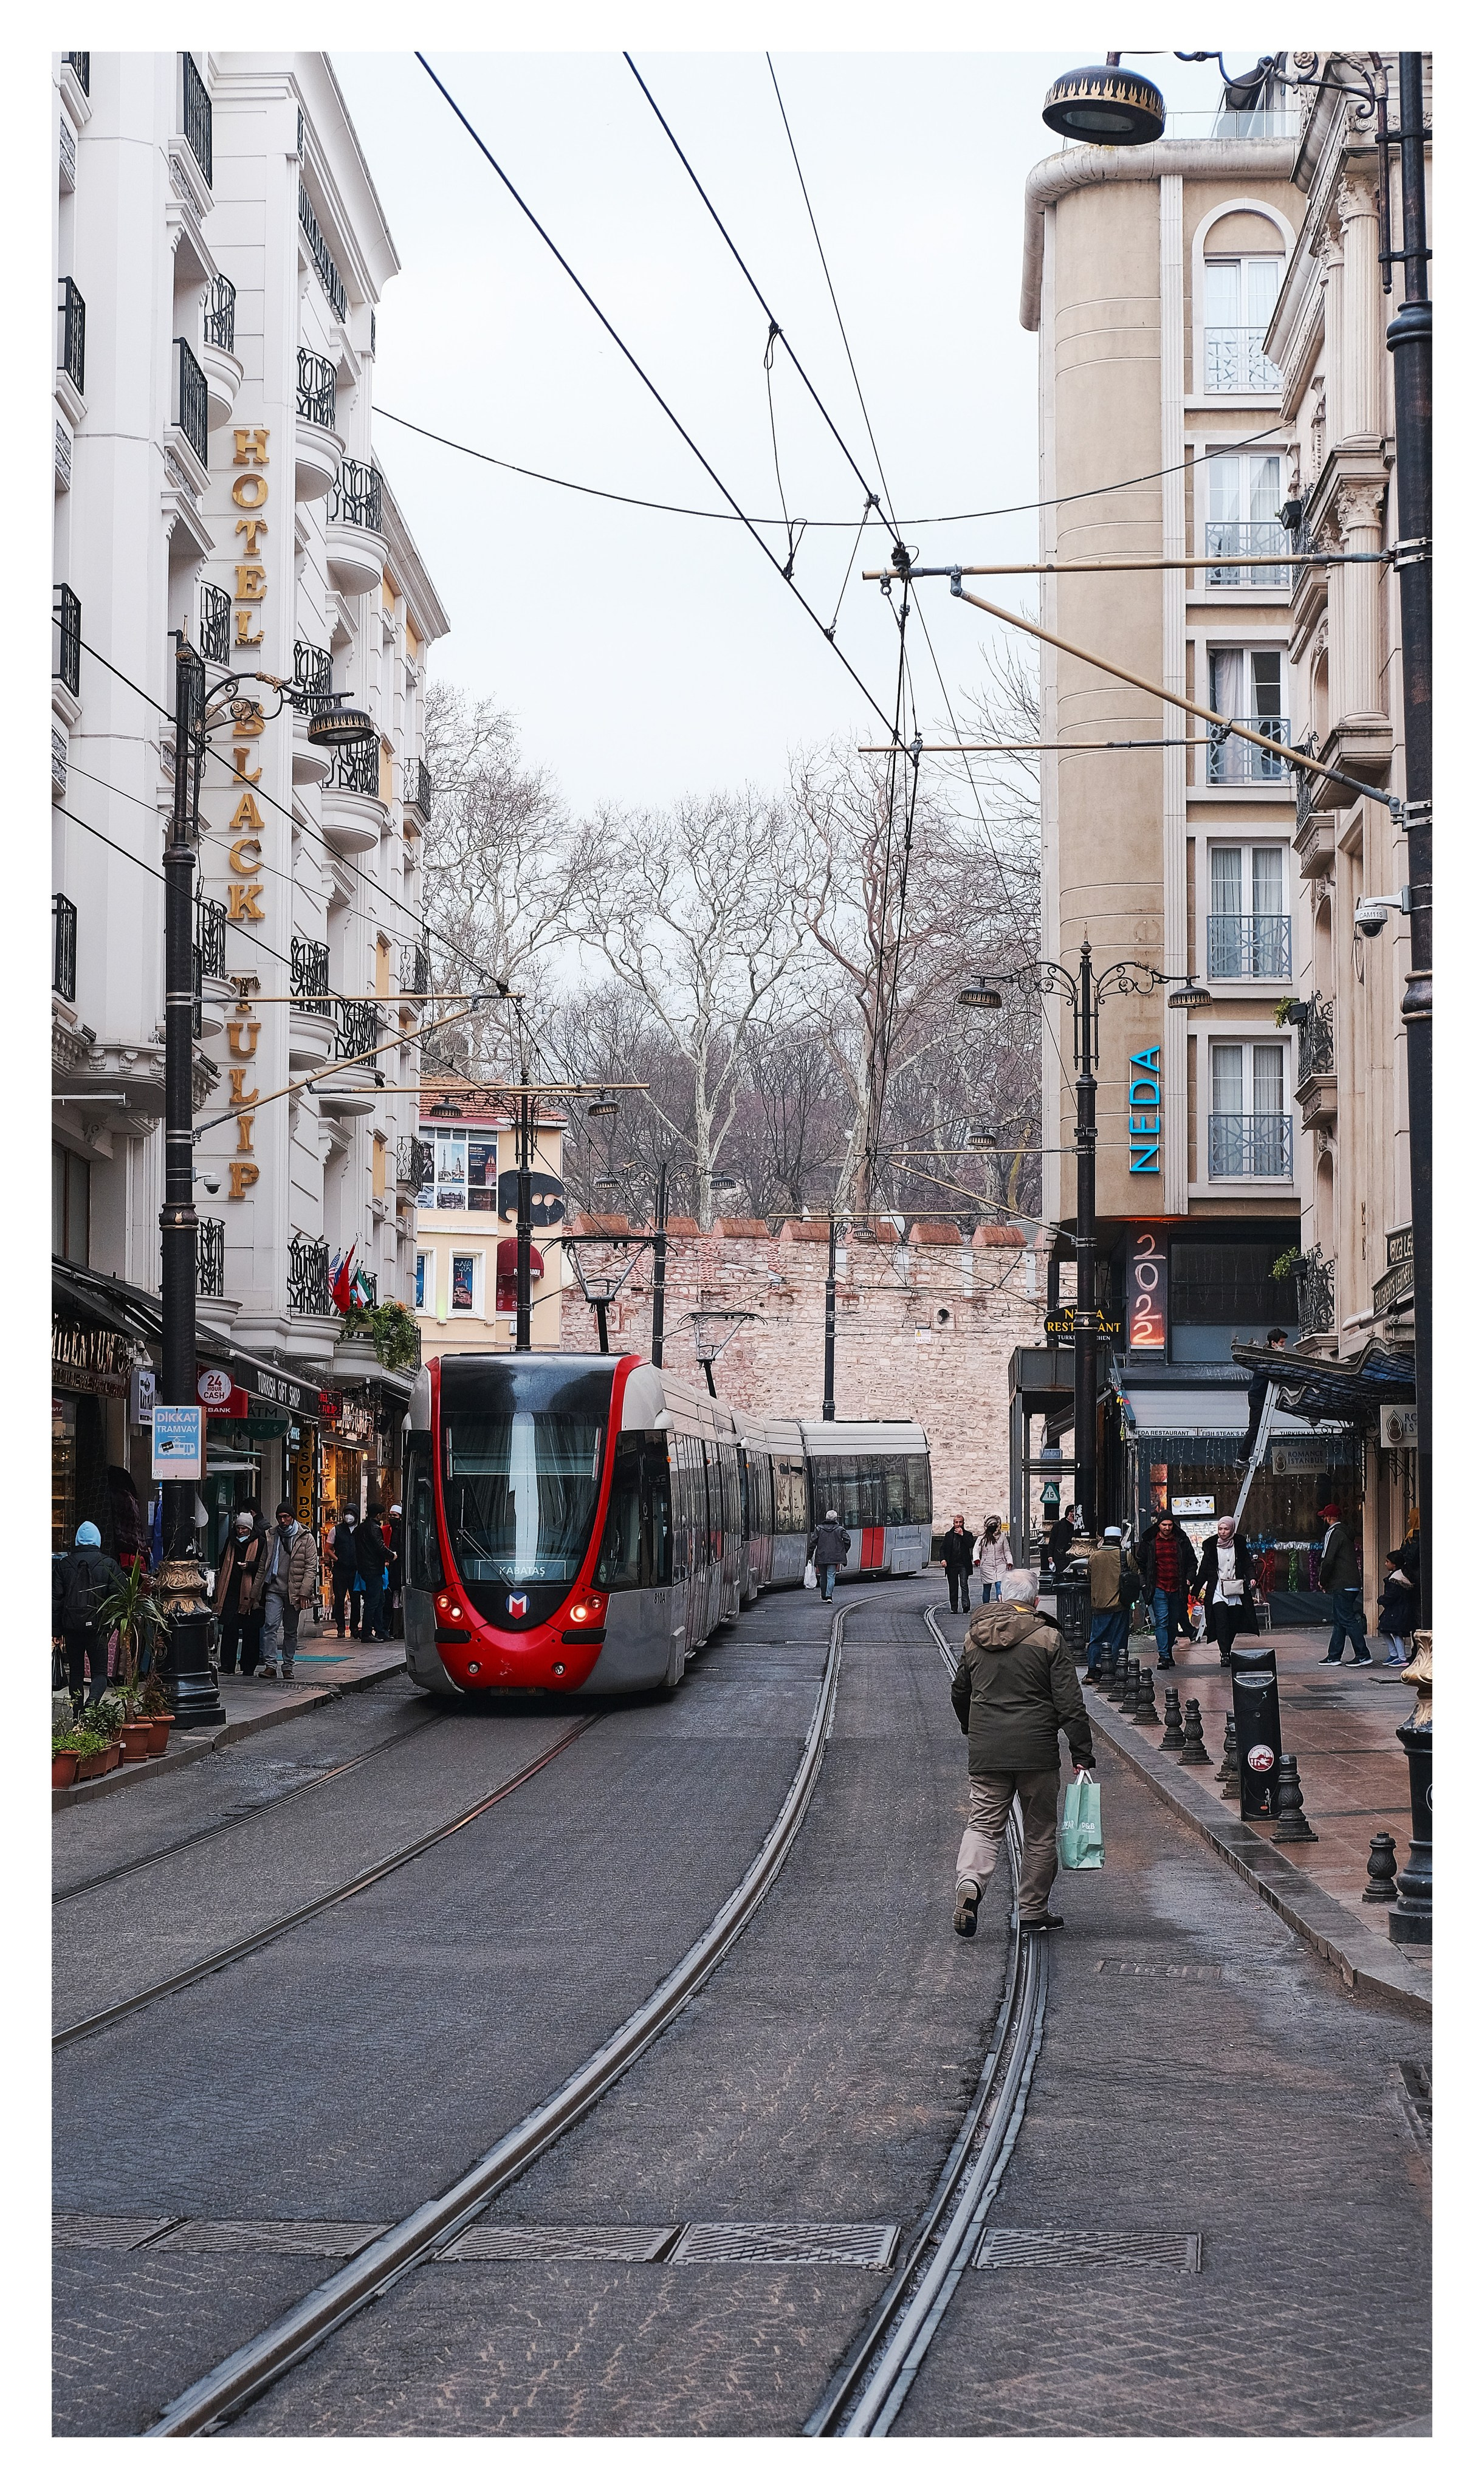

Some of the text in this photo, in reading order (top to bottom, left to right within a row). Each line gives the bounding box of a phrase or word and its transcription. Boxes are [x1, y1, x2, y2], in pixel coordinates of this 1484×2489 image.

[227, 429, 270, 1197] HOTEL BLACK TULIP
[1129, 1045, 1160, 1172] NEDA
[1133, 1234, 1166, 1344] 2022
[1064, 1309, 1105, 1320] NA
[1047, 1322, 1121, 1333] RESTANT
[207, 1375, 222, 1386] 24
[258, 1370, 300, 1408] TURKISH GIFT SHOP
[157, 1412, 198, 1423] DİKKAT
[248, 1406, 278, 1418] ATM
[1404, 1423, 1417, 1432] IS
[300, 1427, 311, 1487] AKSOY
[500, 1567, 545, 1576] KABATAŞ
[654, 1592, 665, 1604] 810A
